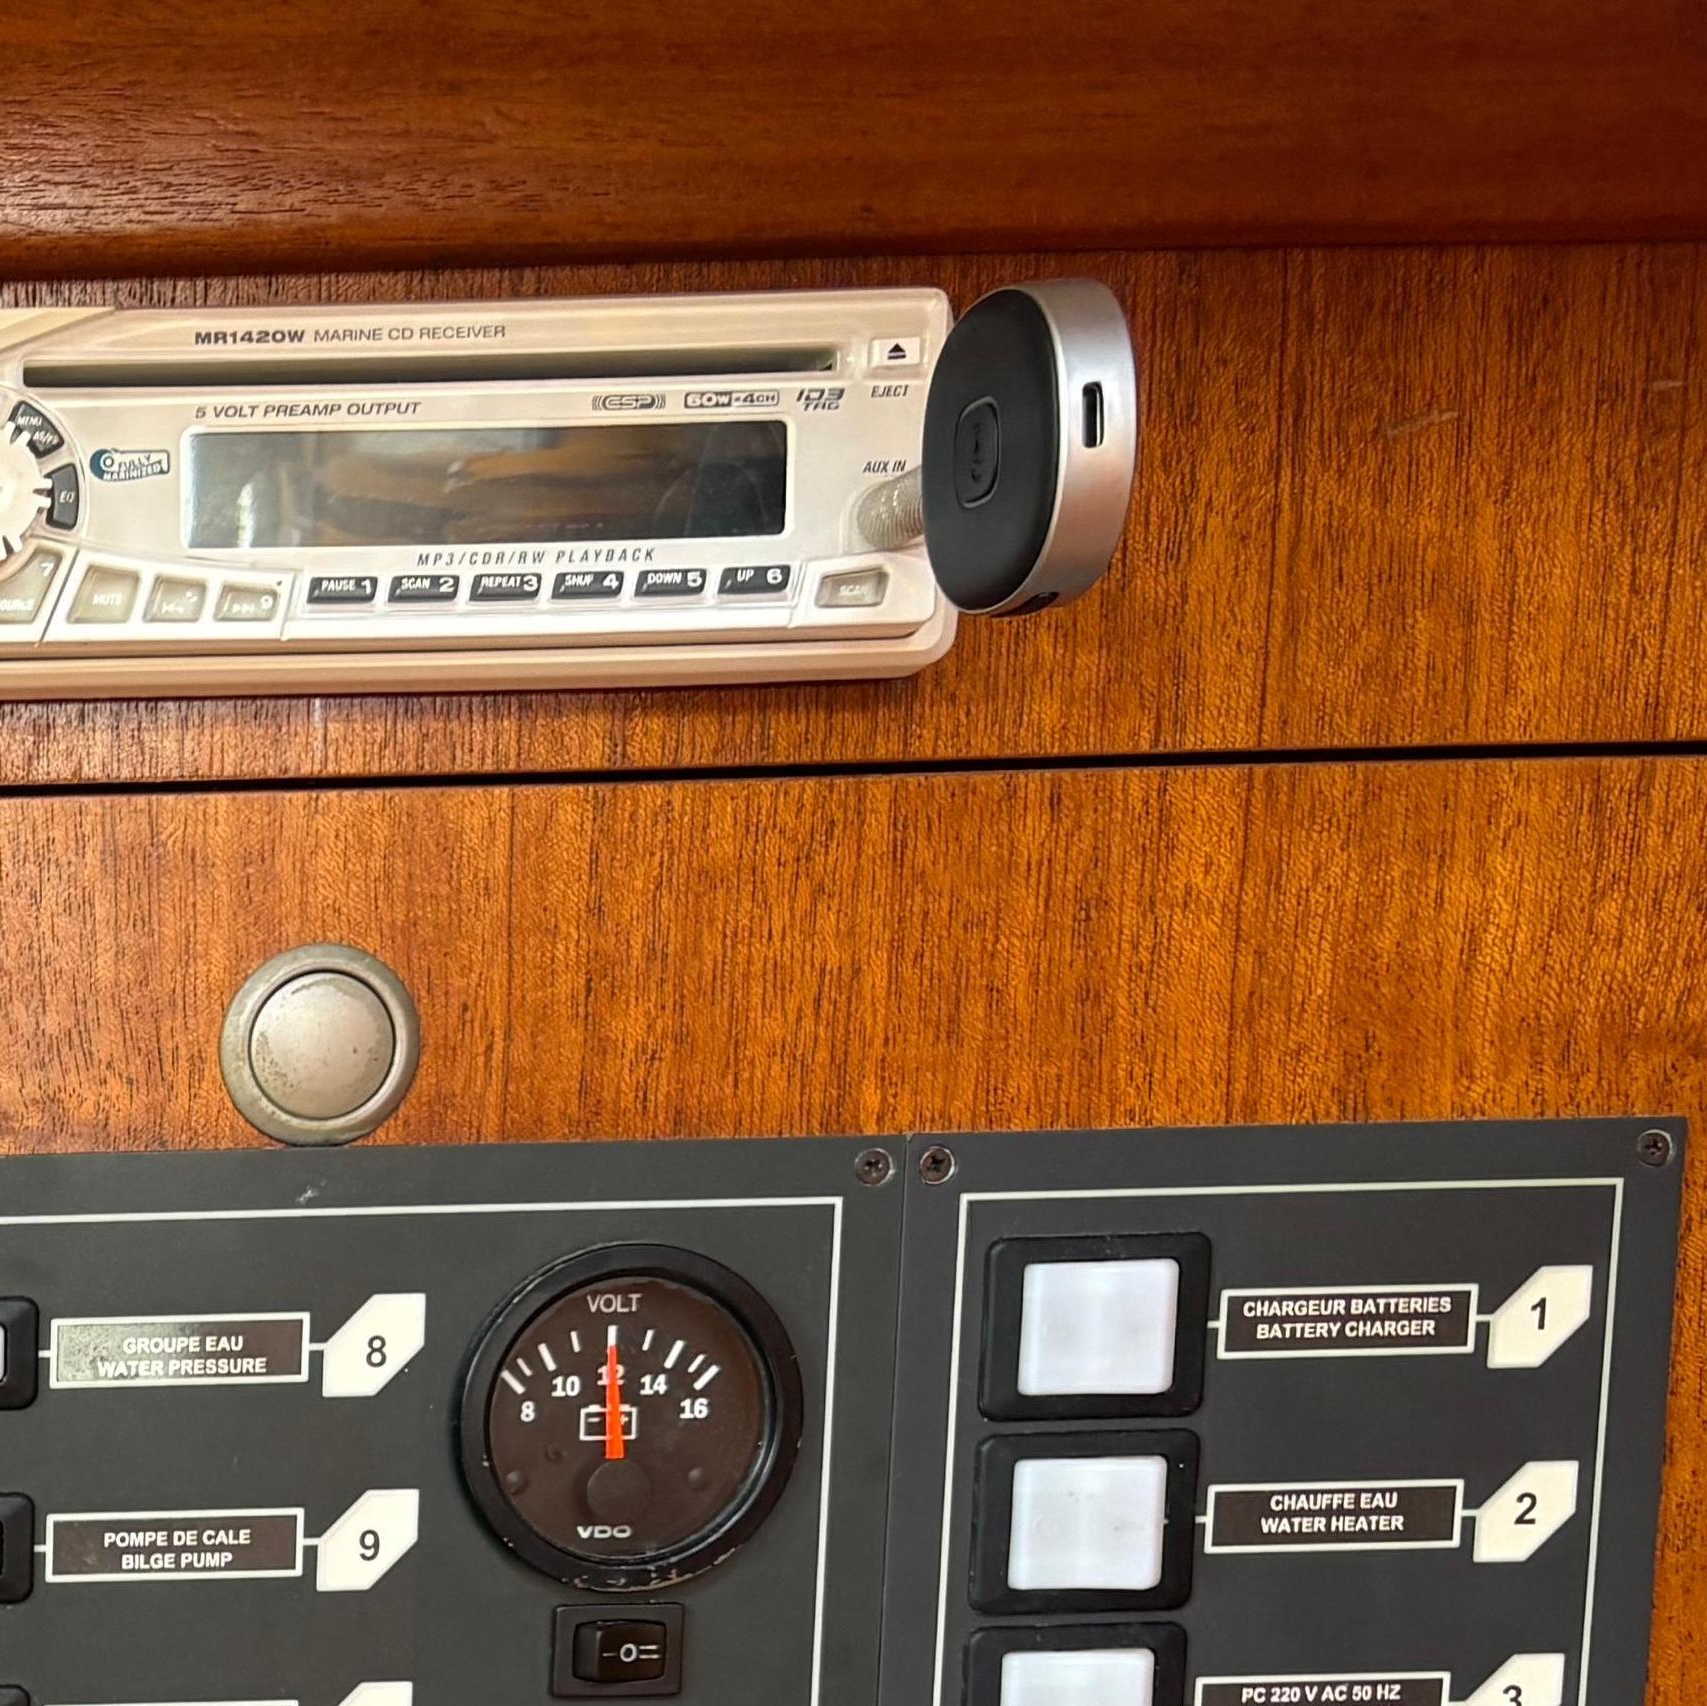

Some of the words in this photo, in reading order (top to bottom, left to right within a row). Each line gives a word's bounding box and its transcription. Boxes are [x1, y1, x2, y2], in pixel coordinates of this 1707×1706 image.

[194, 329, 305, 346] MR1420W
[314, 327, 383, 342] MARINE
[388, 326, 413, 341] CD
[419, 324, 506, 340] RECEIVER
[871, 385, 908, 398] EJECT
[194, 406, 206, 419] 5
[212, 404, 259, 419] VOLT
[263, 403, 341, 417] PREAMP
[347, 401, 421, 416] OUTPUT
[863, 461, 888, 474] AUX
[892, 460, 906, 472] IN
[417, 551, 545, 566] MP3/CDR/RW
[556, 547, 655, 562] PLAYBACK
[401, 577, 429, 590] SCAN
[439, 578, 454, 592] 2
[481, 576, 520, 589] REPEAT
[523, 576, 538, 592] 3
[647, 572, 681, 585] DOWN
[687, 572, 702, 586] 5
[737, 568, 754, 581] UP
[767, 568, 782, 584] 6
[321, 580, 355, 592] PAUSE
[361, 580, 372, 594] 1
[587, 1293, 642, 1312] VOLT
[1243, 1300, 1346, 1317] CHARGEUR
[1351, 1297, 1452, 1314] BATTERIES
[1256, 1322, 1340, 1339] BATTERY
[1346, 1320, 1435, 1337] CHARGER
[121, 1336, 201, 1354] GROUPE
[205, 1334, 244, 1352] EAU
[365, 1335, 387, 1368] 8
[97, 1359, 161, 1377] WATER
[163, 1356, 267, 1375] PRESSURE
[552, 1375, 579, 1397] 10
[640, 1375, 668, 1395] 14
[520, 1401, 536, 1422] 8
[680, 1399, 708, 1419] 16
[1270, 1494, 1355, 1510] CHAUFFE
[1360, 1493, 1398, 1508] EAU
[1514, 1493, 1536, 1525] 2
[577, 1526, 631, 1539] VDO
[1260, 1517, 1327, 1533] WATER
[1331, 1515, 1404, 1531] HEATER
[103, 1530, 172, 1549] POMPE
[175, 1530, 200, 1547] DE
[203, 1529, 250, 1545] CALE
[357, 1529, 381, 1561] 9
[120, 1552, 177, 1570] BILGE
[180, 1551, 233, 1568] PUMP
